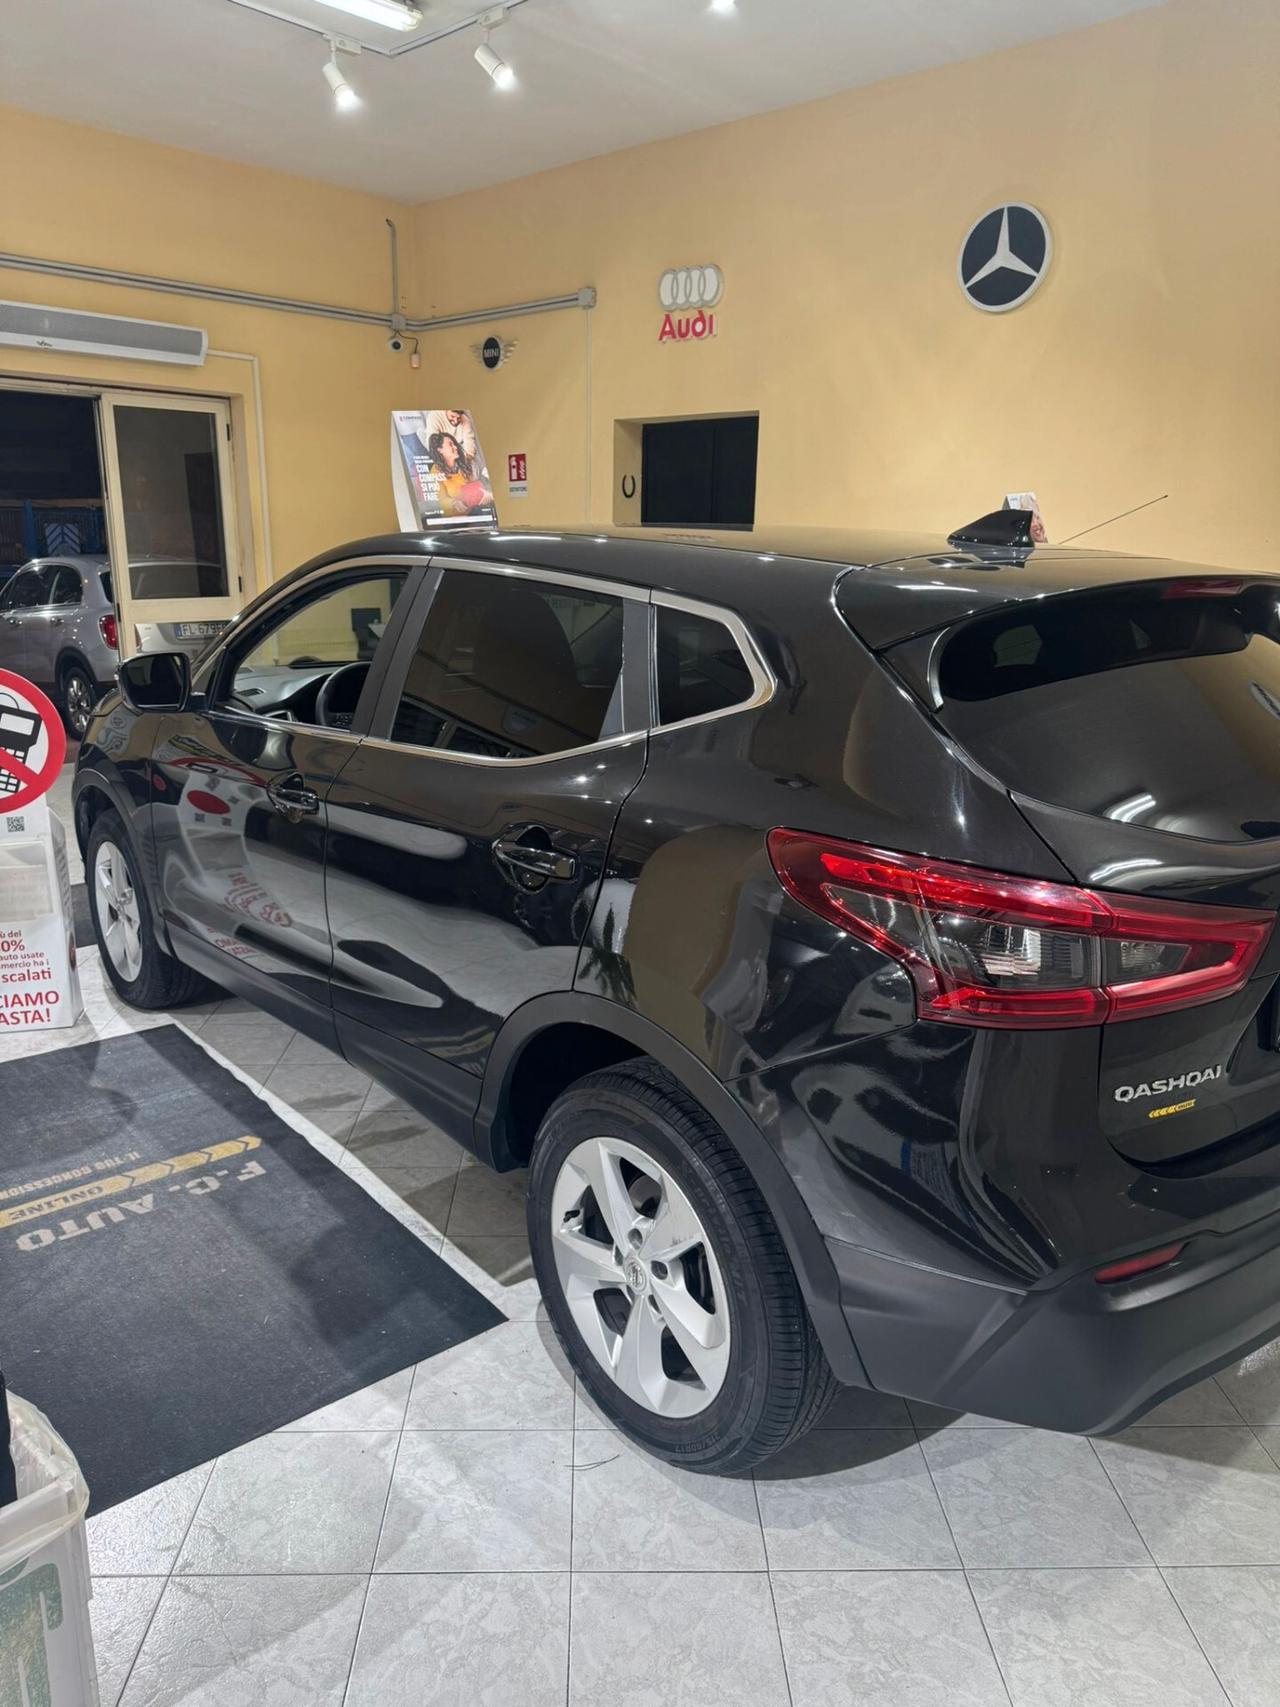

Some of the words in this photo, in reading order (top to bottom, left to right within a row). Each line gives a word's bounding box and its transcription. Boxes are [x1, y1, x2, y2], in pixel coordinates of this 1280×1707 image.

[658, 309, 714, 341] Audi
[483, 347, 500, 358] MINI
[415, 464, 430, 473] CON
[418, 472, 448, 483] COMPASS
[423, 491, 440, 502] FARE
[7, 929, 22, 938] del
[20, 950, 45, 960] usate
[33, 959, 44, 967] ha
[1, 967, 52, 983] scalati
[0, 1007, 52, 1026] ASTA!
[1114, 1064, 1222, 1103] QASHQAI
[9, 1185, 104, 1221] ONLINE
[15, 1193, 154, 1251] AUTO
